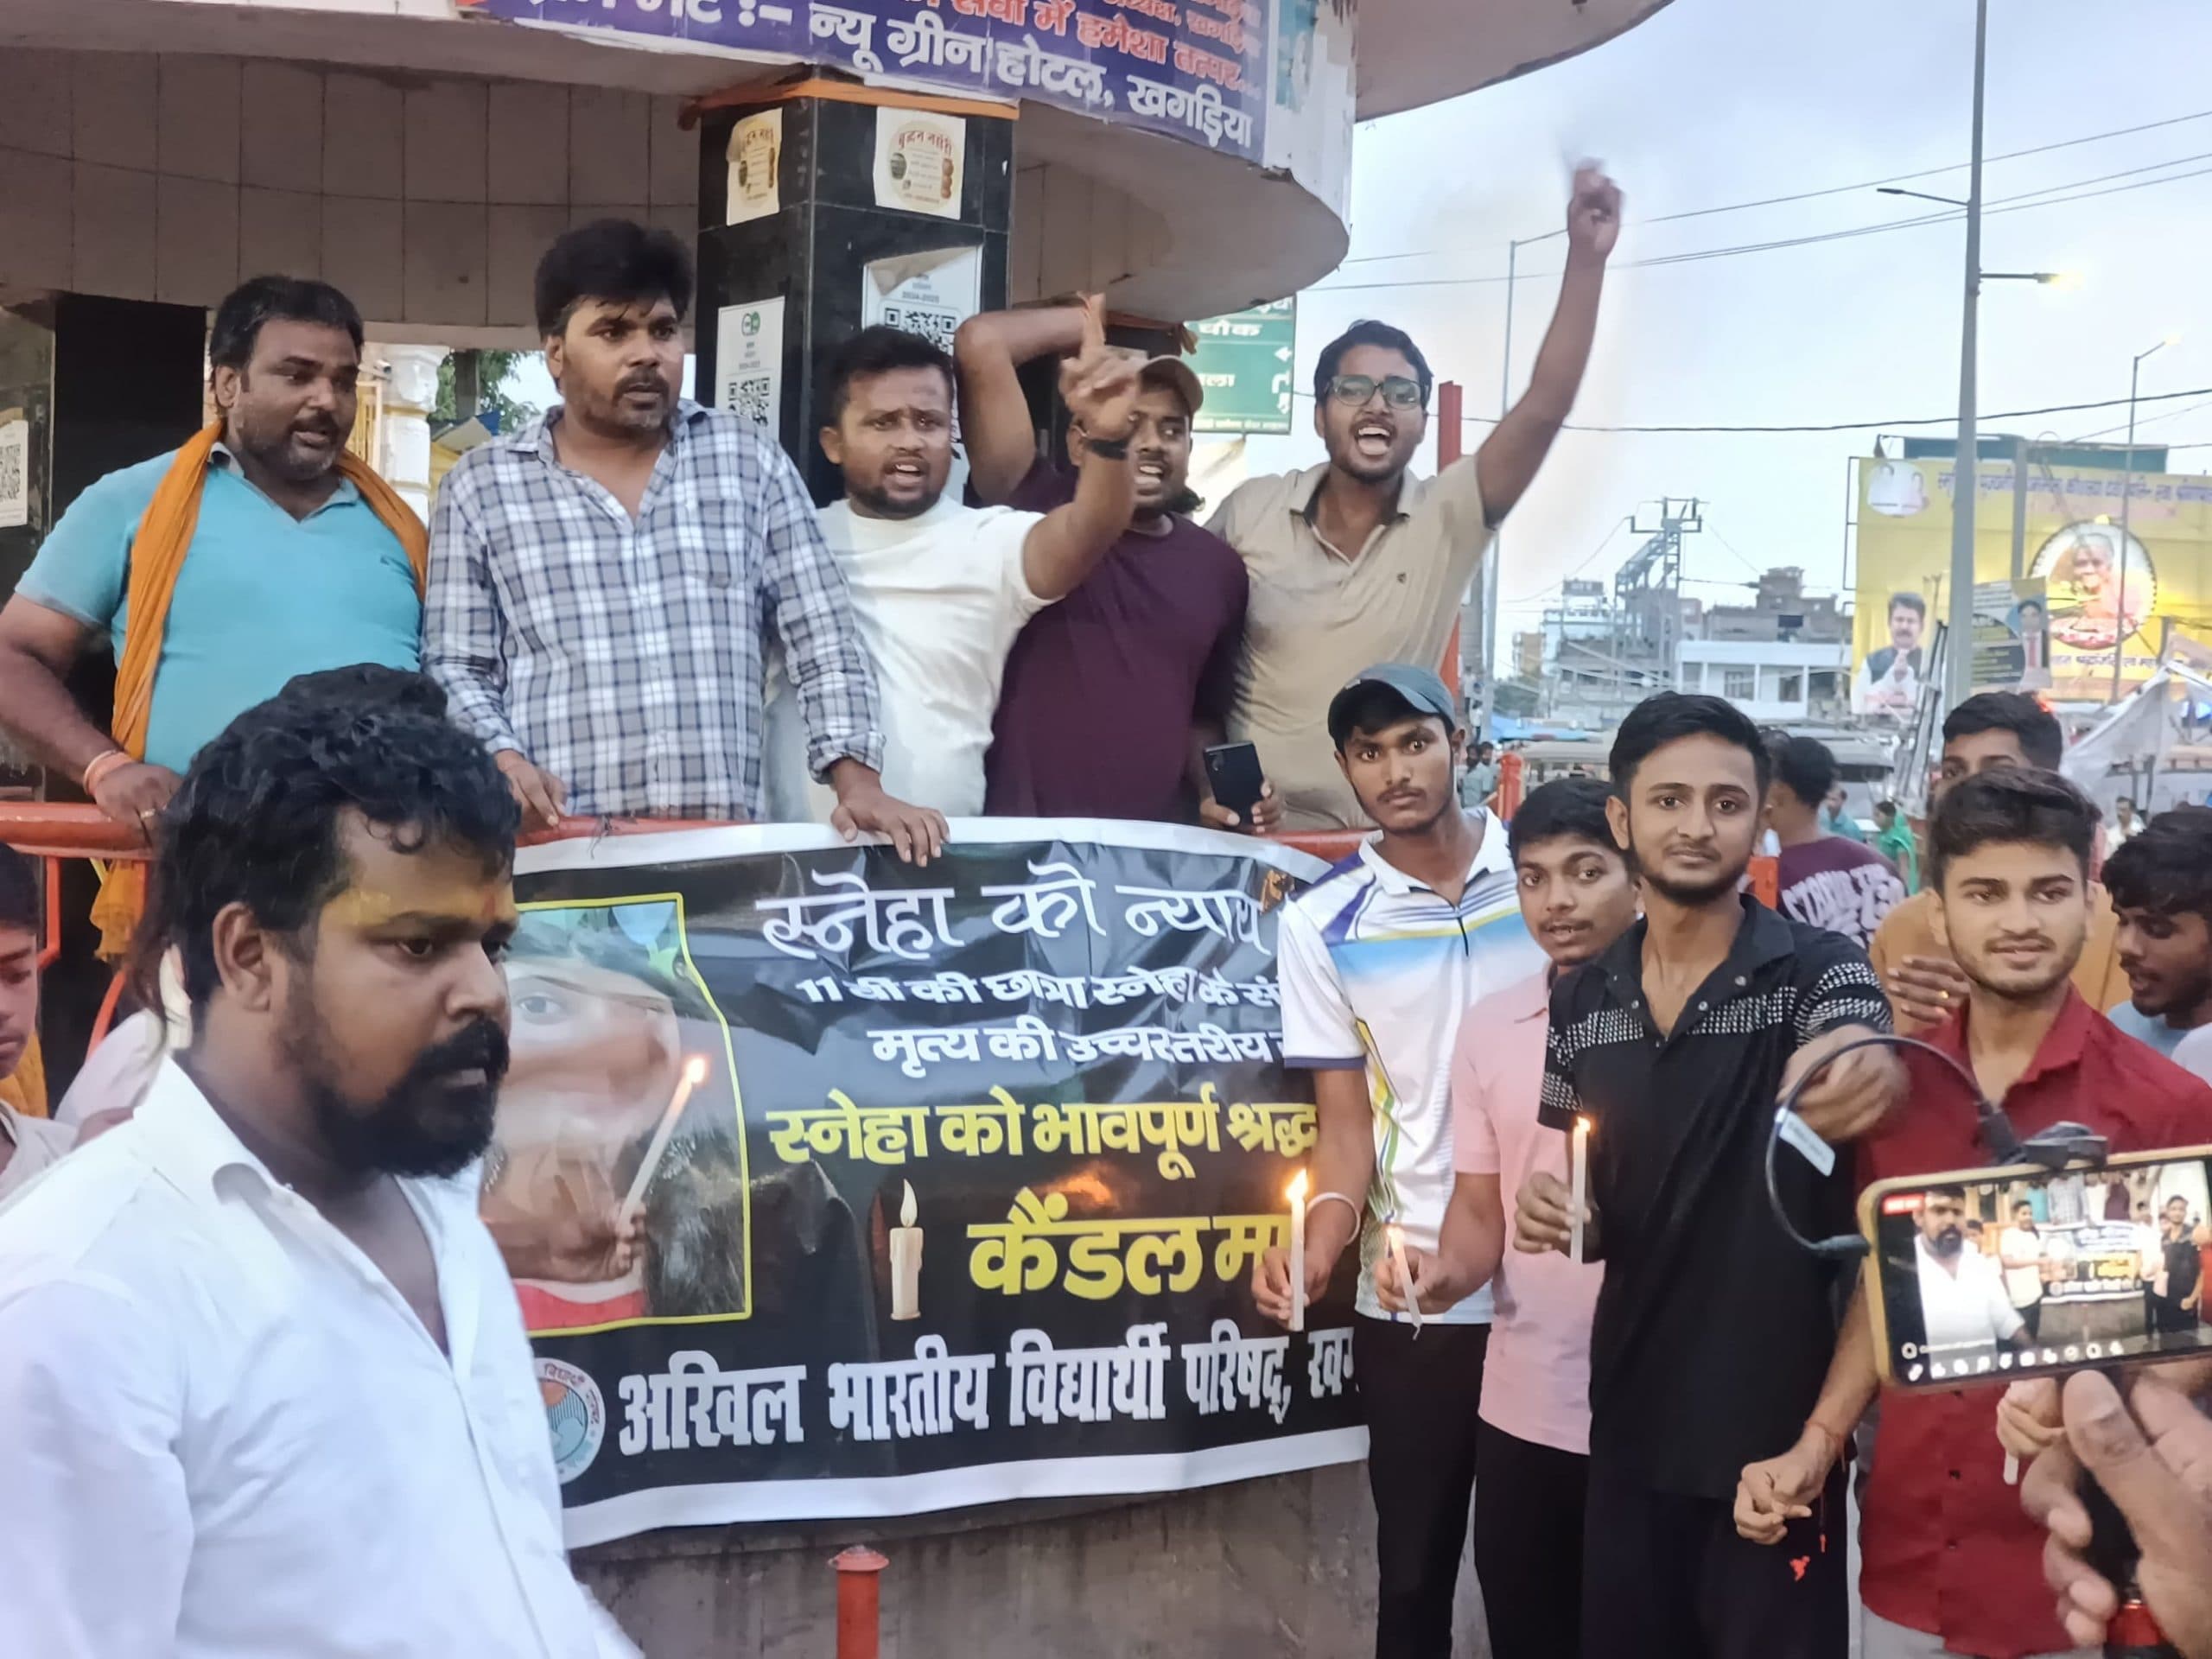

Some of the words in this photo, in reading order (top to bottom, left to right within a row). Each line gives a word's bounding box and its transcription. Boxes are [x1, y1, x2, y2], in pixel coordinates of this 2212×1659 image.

[810, 3, 883, 73] न्यू
[887, 10, 989, 73] ग्रीन
[996, 34, 1115, 107] होटल,
[1127, 74, 1253, 148] खगड़िया
[1033, 0, 1076, 36] में
[1077, 12, 1169, 65] हमेशा
[755, 869, 964, 960] स्नेहा
[981, 860, 1106, 938] को
[796, 976, 843, 1002] 11
[904, 971, 983, 1003] की
[982, 969, 1090, 1009] छात्रा
[1090, 965, 1198, 1005] स्नेहा
[1198, 967, 1239, 1007] के
[1237, 976, 1280, 1007] सं
[983, 1014, 1058, 1061] की
[766, 1089, 929, 1165] स्नेहा
[936, 1084, 1025, 1156] को
[1032, 1082, 1220, 1180] भावपूर्ण
[1226, 1103, 1318, 1158] श्रद्ध
[967, 1186, 1211, 1300] कैंडल
[1213, 1214, 1292, 1282] मा
[618, 1350, 806, 1455] अखिल
[827, 1333, 995, 1442] भारतीय
[1005, 1322, 1171, 1427] विद्यार्थी
